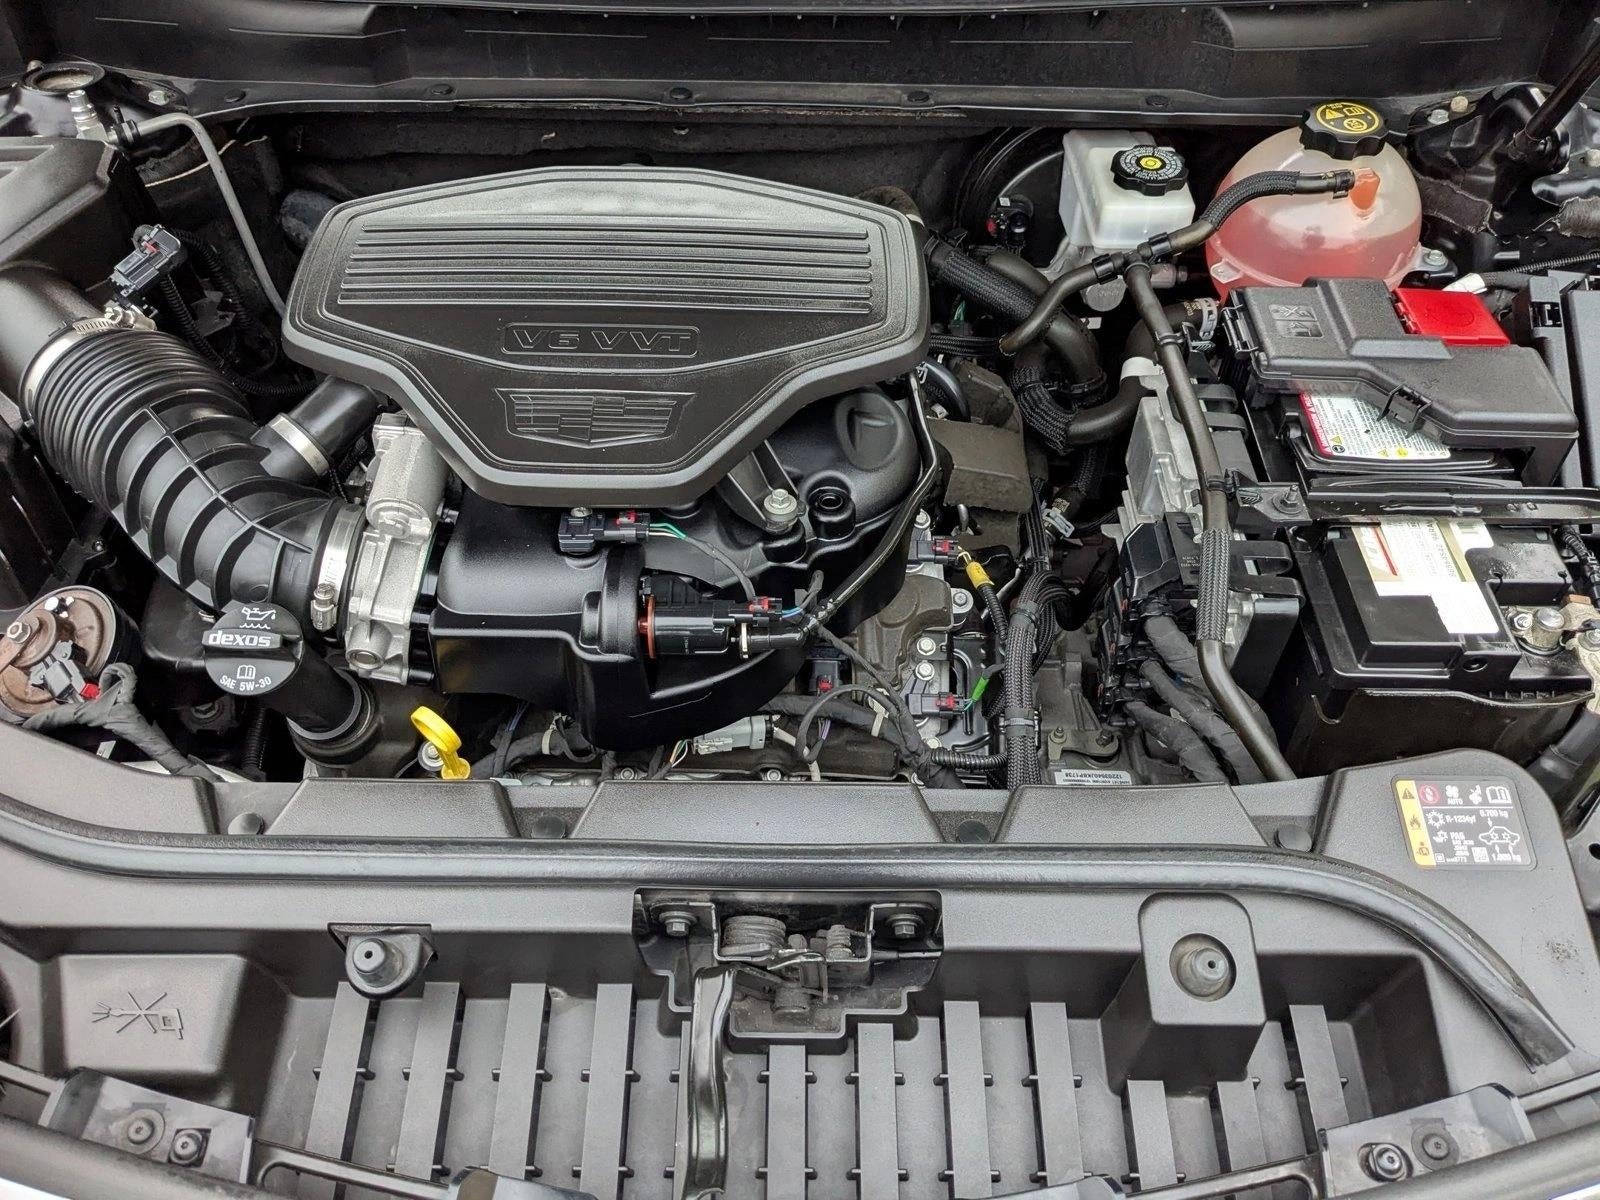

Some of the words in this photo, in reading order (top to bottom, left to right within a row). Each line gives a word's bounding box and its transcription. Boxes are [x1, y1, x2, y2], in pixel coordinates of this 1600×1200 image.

[512, 329, 580, 350] V6
[590, 330, 692, 352] VVT
[208, 630, 271, 647] dexos
[219, 675, 237, 689] SAE
[239, 676, 272, 691] 5W-30
[1499, 810, 1509, 819] kg
[1450, 832, 1466, 840] PAG
